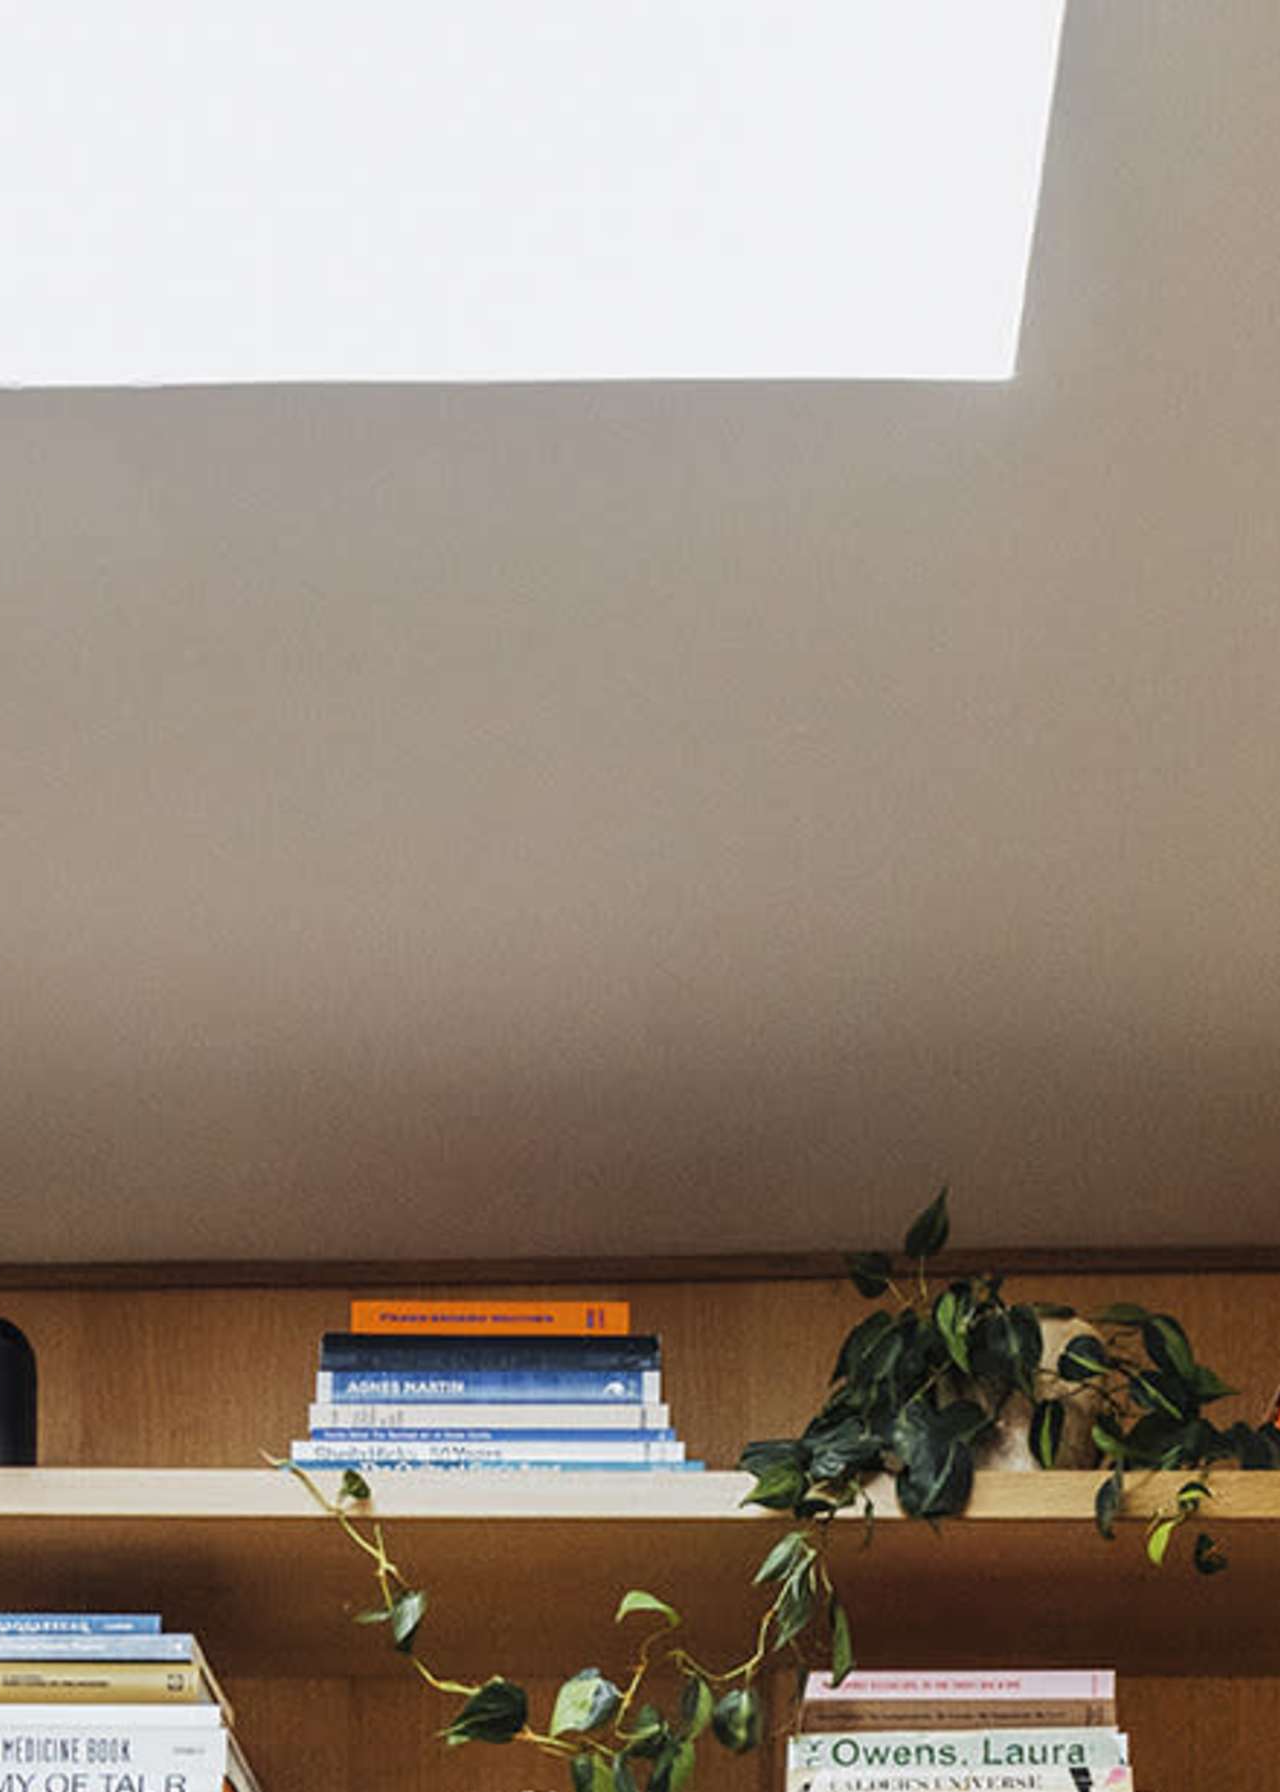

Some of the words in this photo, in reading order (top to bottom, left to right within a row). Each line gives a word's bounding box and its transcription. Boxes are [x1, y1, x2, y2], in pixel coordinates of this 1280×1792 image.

[347, 1380, 400, 1394] AGNES
[404, 1380, 464, 1394] MARTIN
[2, 1737, 79, 1763] MEDICINE
[86, 1737, 132, 1762] BOOK
[982, 1737, 1086, 1766] Laura
